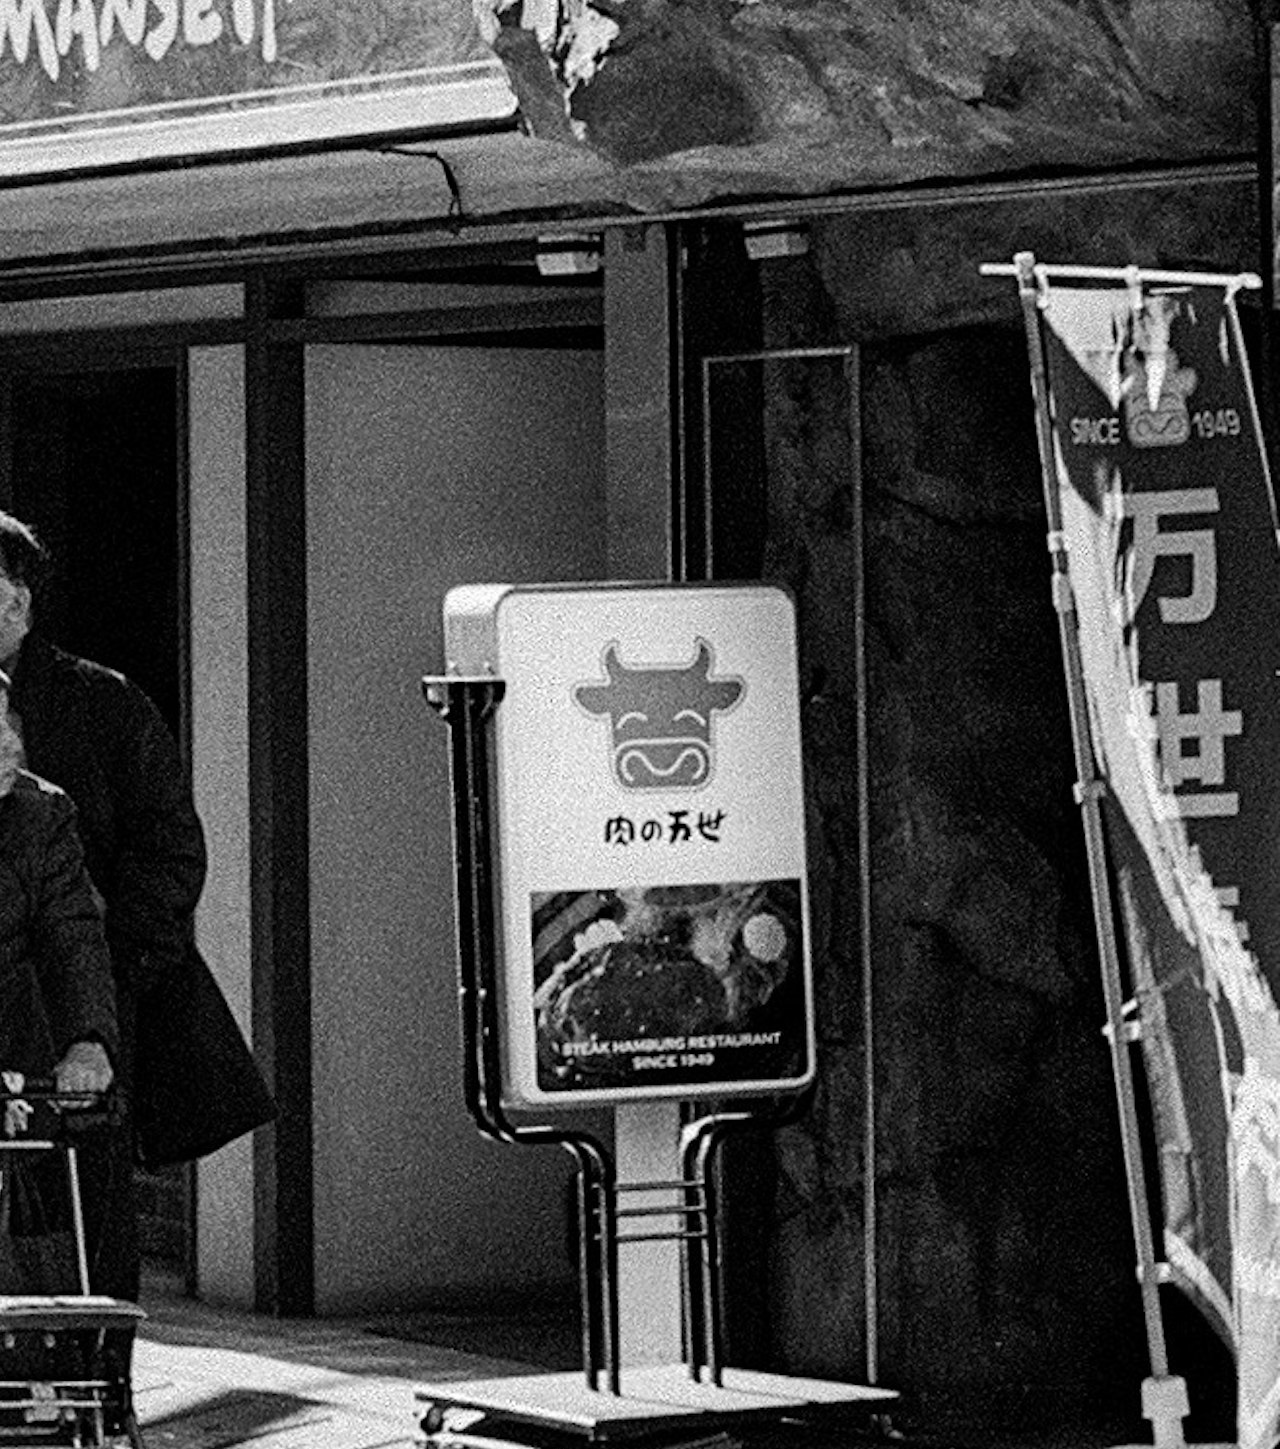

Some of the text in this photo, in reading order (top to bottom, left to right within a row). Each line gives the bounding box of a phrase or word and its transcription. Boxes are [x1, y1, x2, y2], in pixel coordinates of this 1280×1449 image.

[1070, 408, 1241, 446] SINCE 1949
[604, 808, 727, 846] 肉の万世
[562, 1031, 782, 1057] STEAK HAMBURG RESTAURANT
